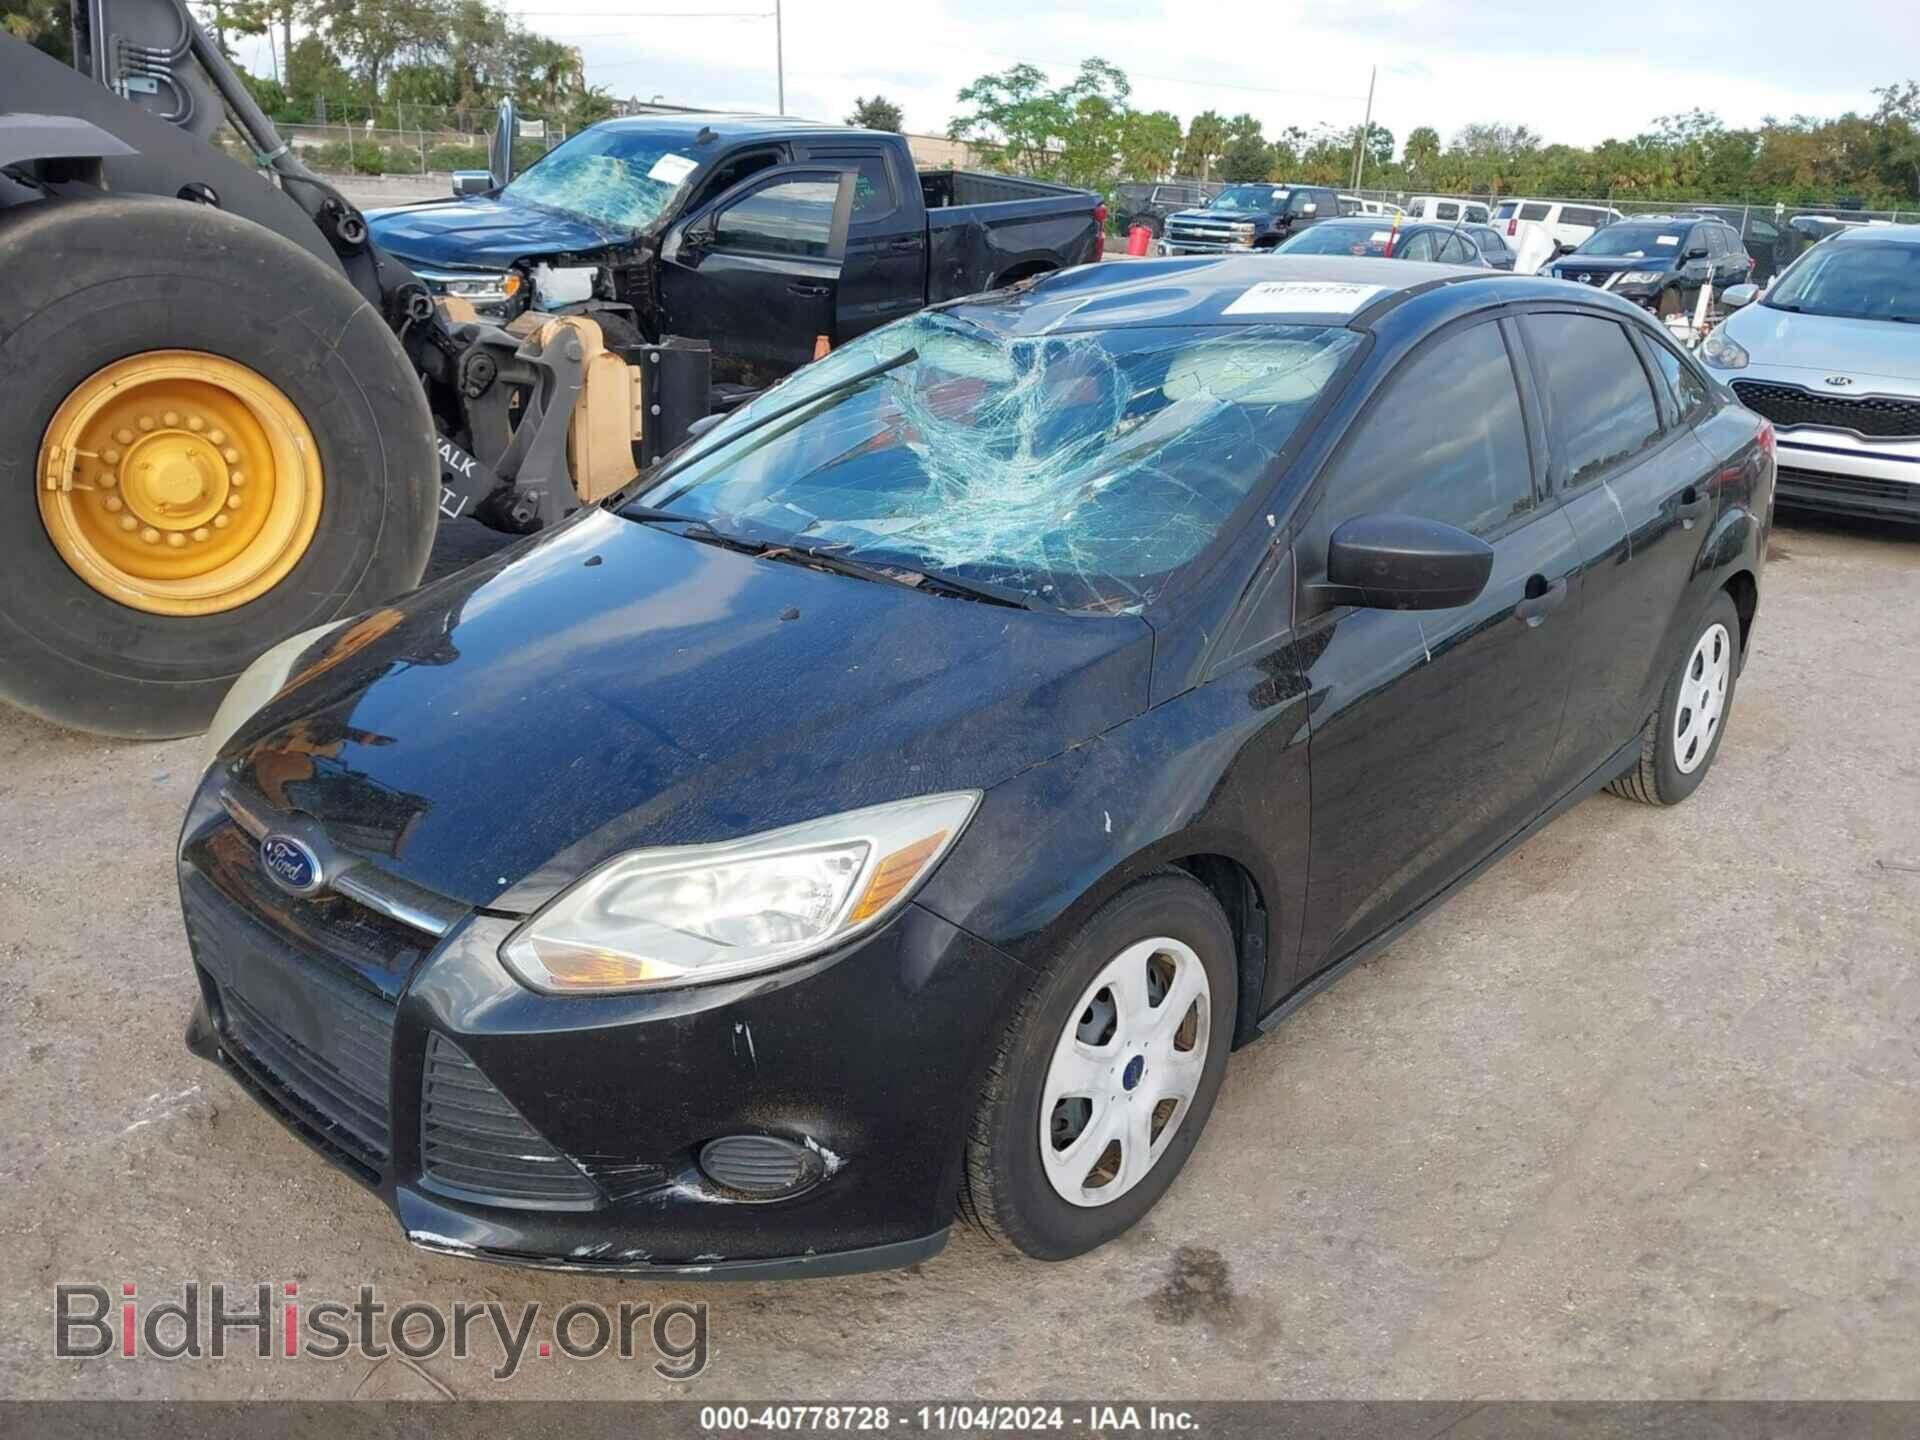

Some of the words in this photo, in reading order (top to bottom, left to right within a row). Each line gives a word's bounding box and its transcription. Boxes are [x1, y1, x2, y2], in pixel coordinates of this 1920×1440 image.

[1827, 376, 1850, 386] KIA
[436, 438, 477, 478] ALK
[268, 843, 303, 881] Ford
